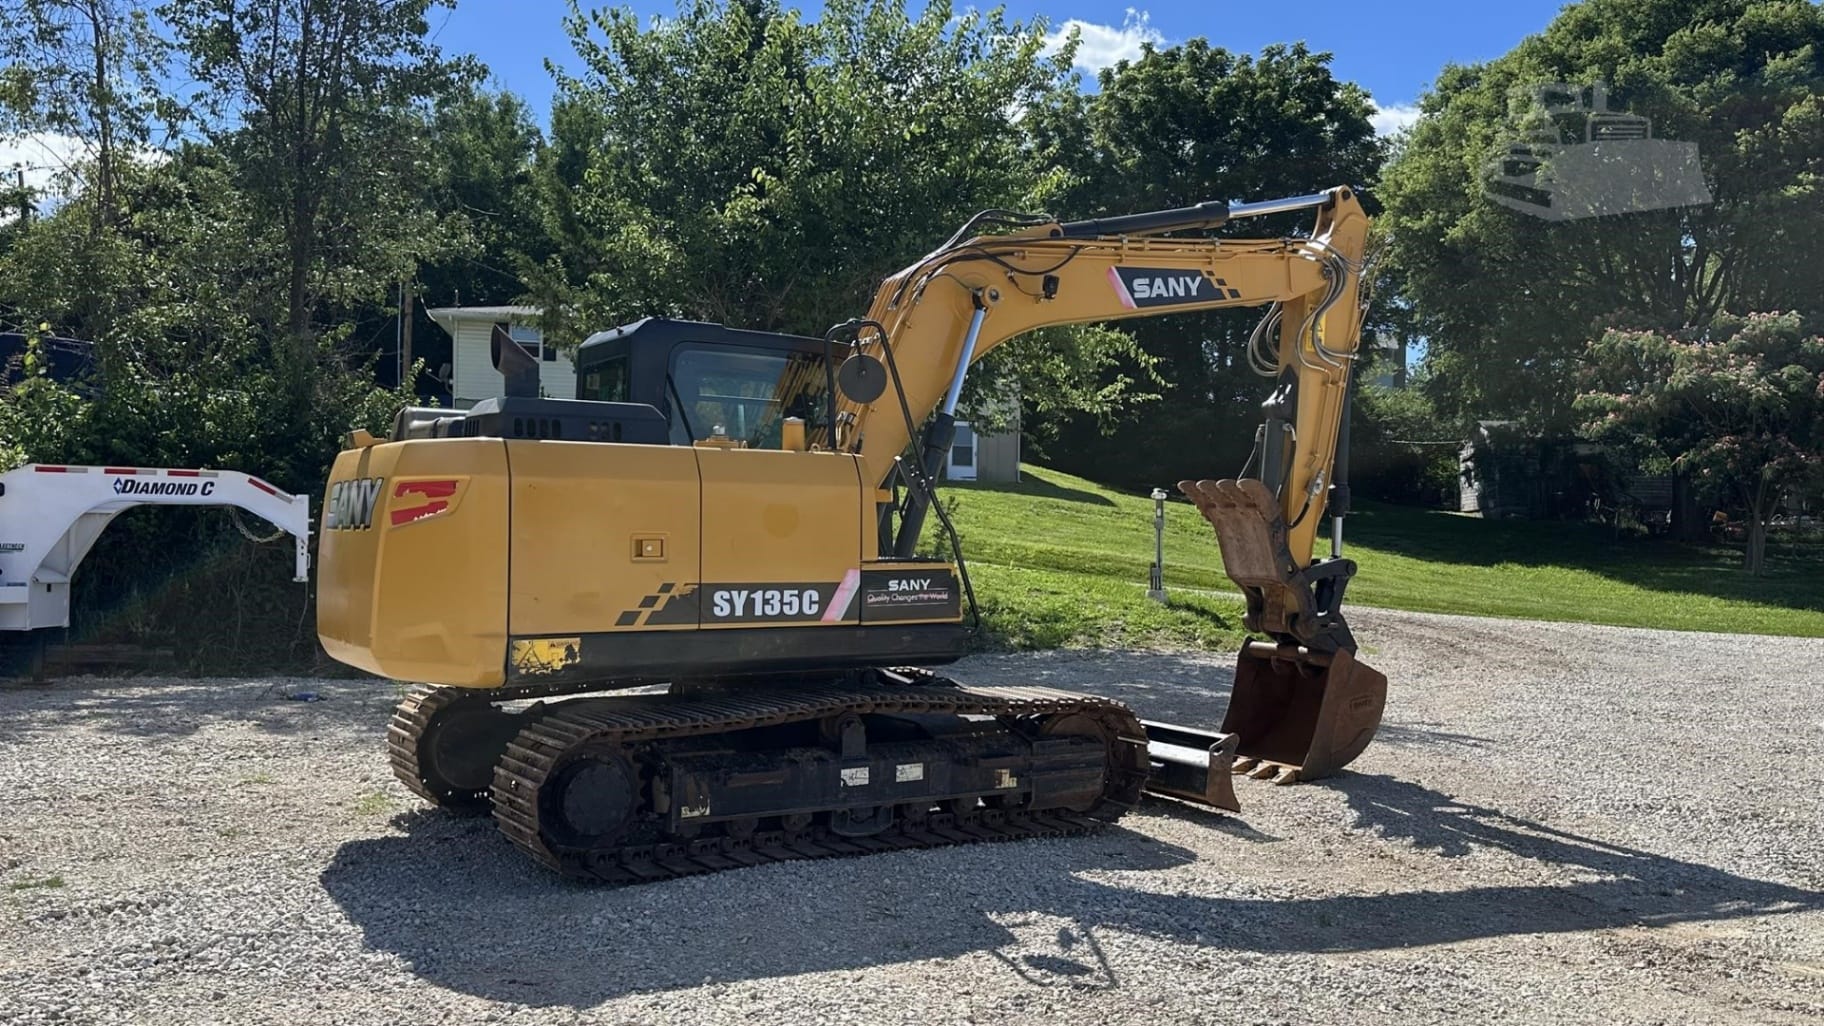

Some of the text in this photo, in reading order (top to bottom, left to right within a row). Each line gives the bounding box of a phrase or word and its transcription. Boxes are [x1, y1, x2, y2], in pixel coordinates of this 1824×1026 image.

[1132, 276, 1202, 298] SANY
[121, 479, 215, 496] DIAMOND C
[327, 477, 384, 529] SANY
[888, 579, 931, 592] SANY
[713, 589, 819, 617] SY135C
[867, 593, 890, 604] Quality
[891, 592, 918, 602] Changes
[930, 591, 949, 600] World
